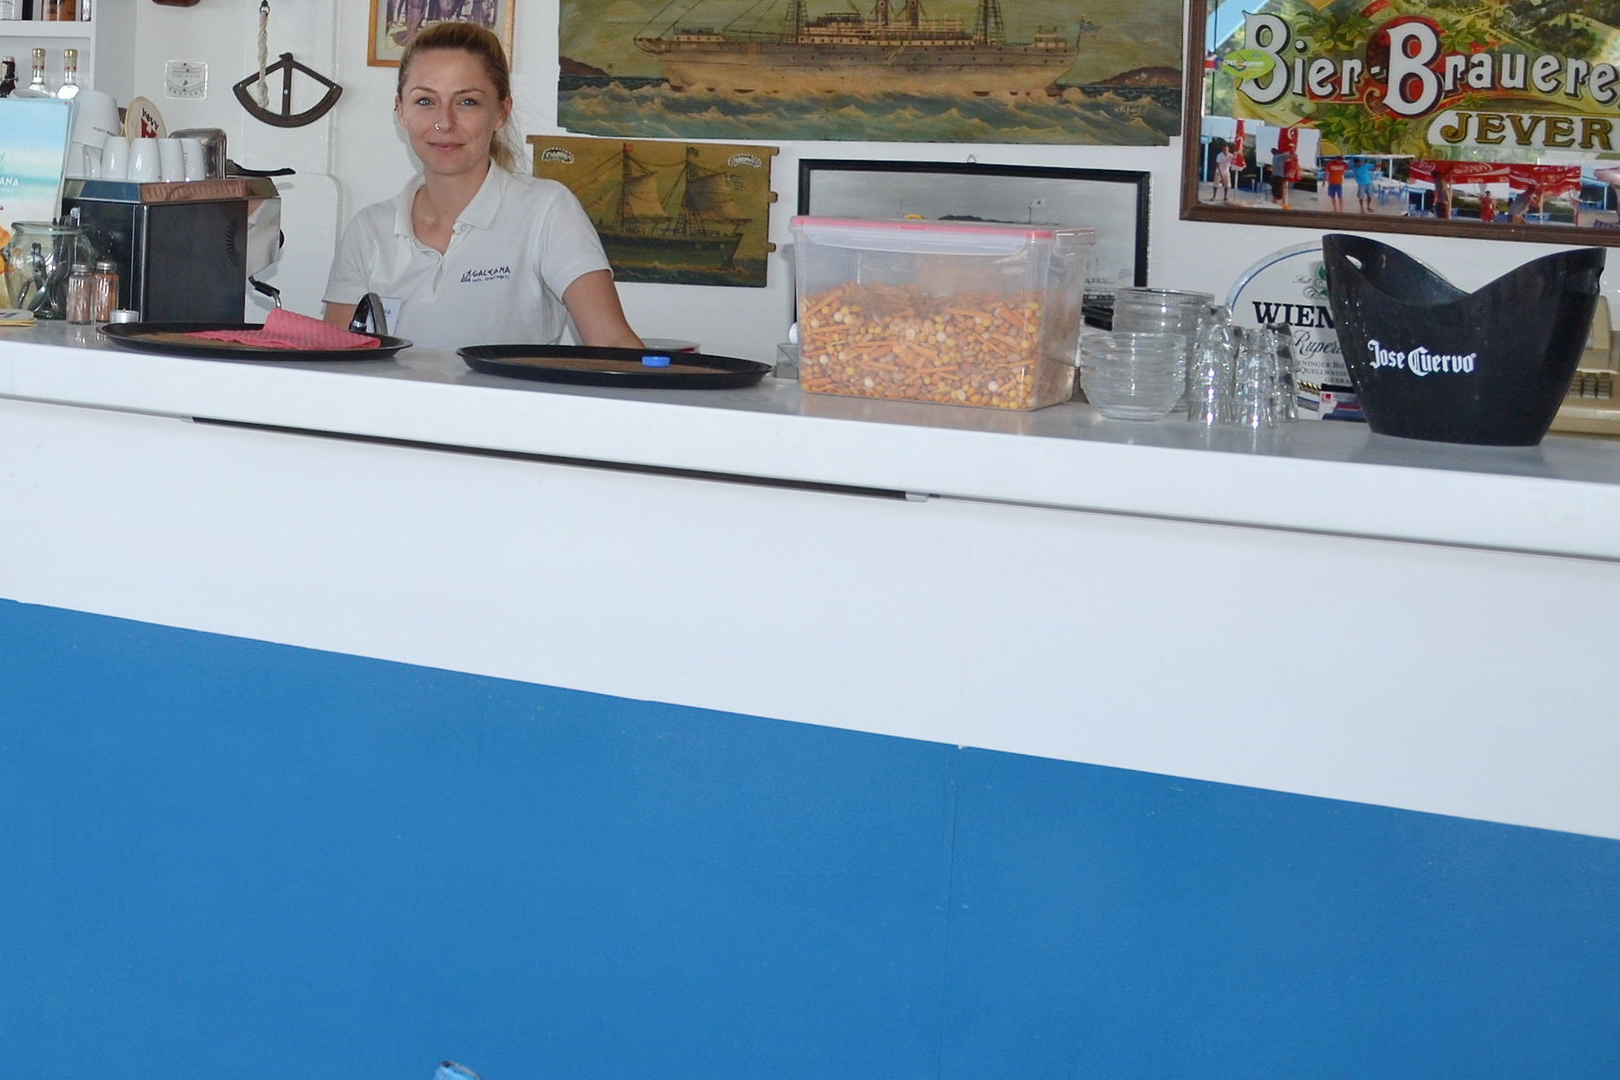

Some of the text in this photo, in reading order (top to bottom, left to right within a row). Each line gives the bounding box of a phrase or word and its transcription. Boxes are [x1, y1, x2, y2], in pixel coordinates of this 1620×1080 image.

[1440, 111, 1612, 150] JEVER
[1367, 339, 1476, 377] Jose Cuervo
